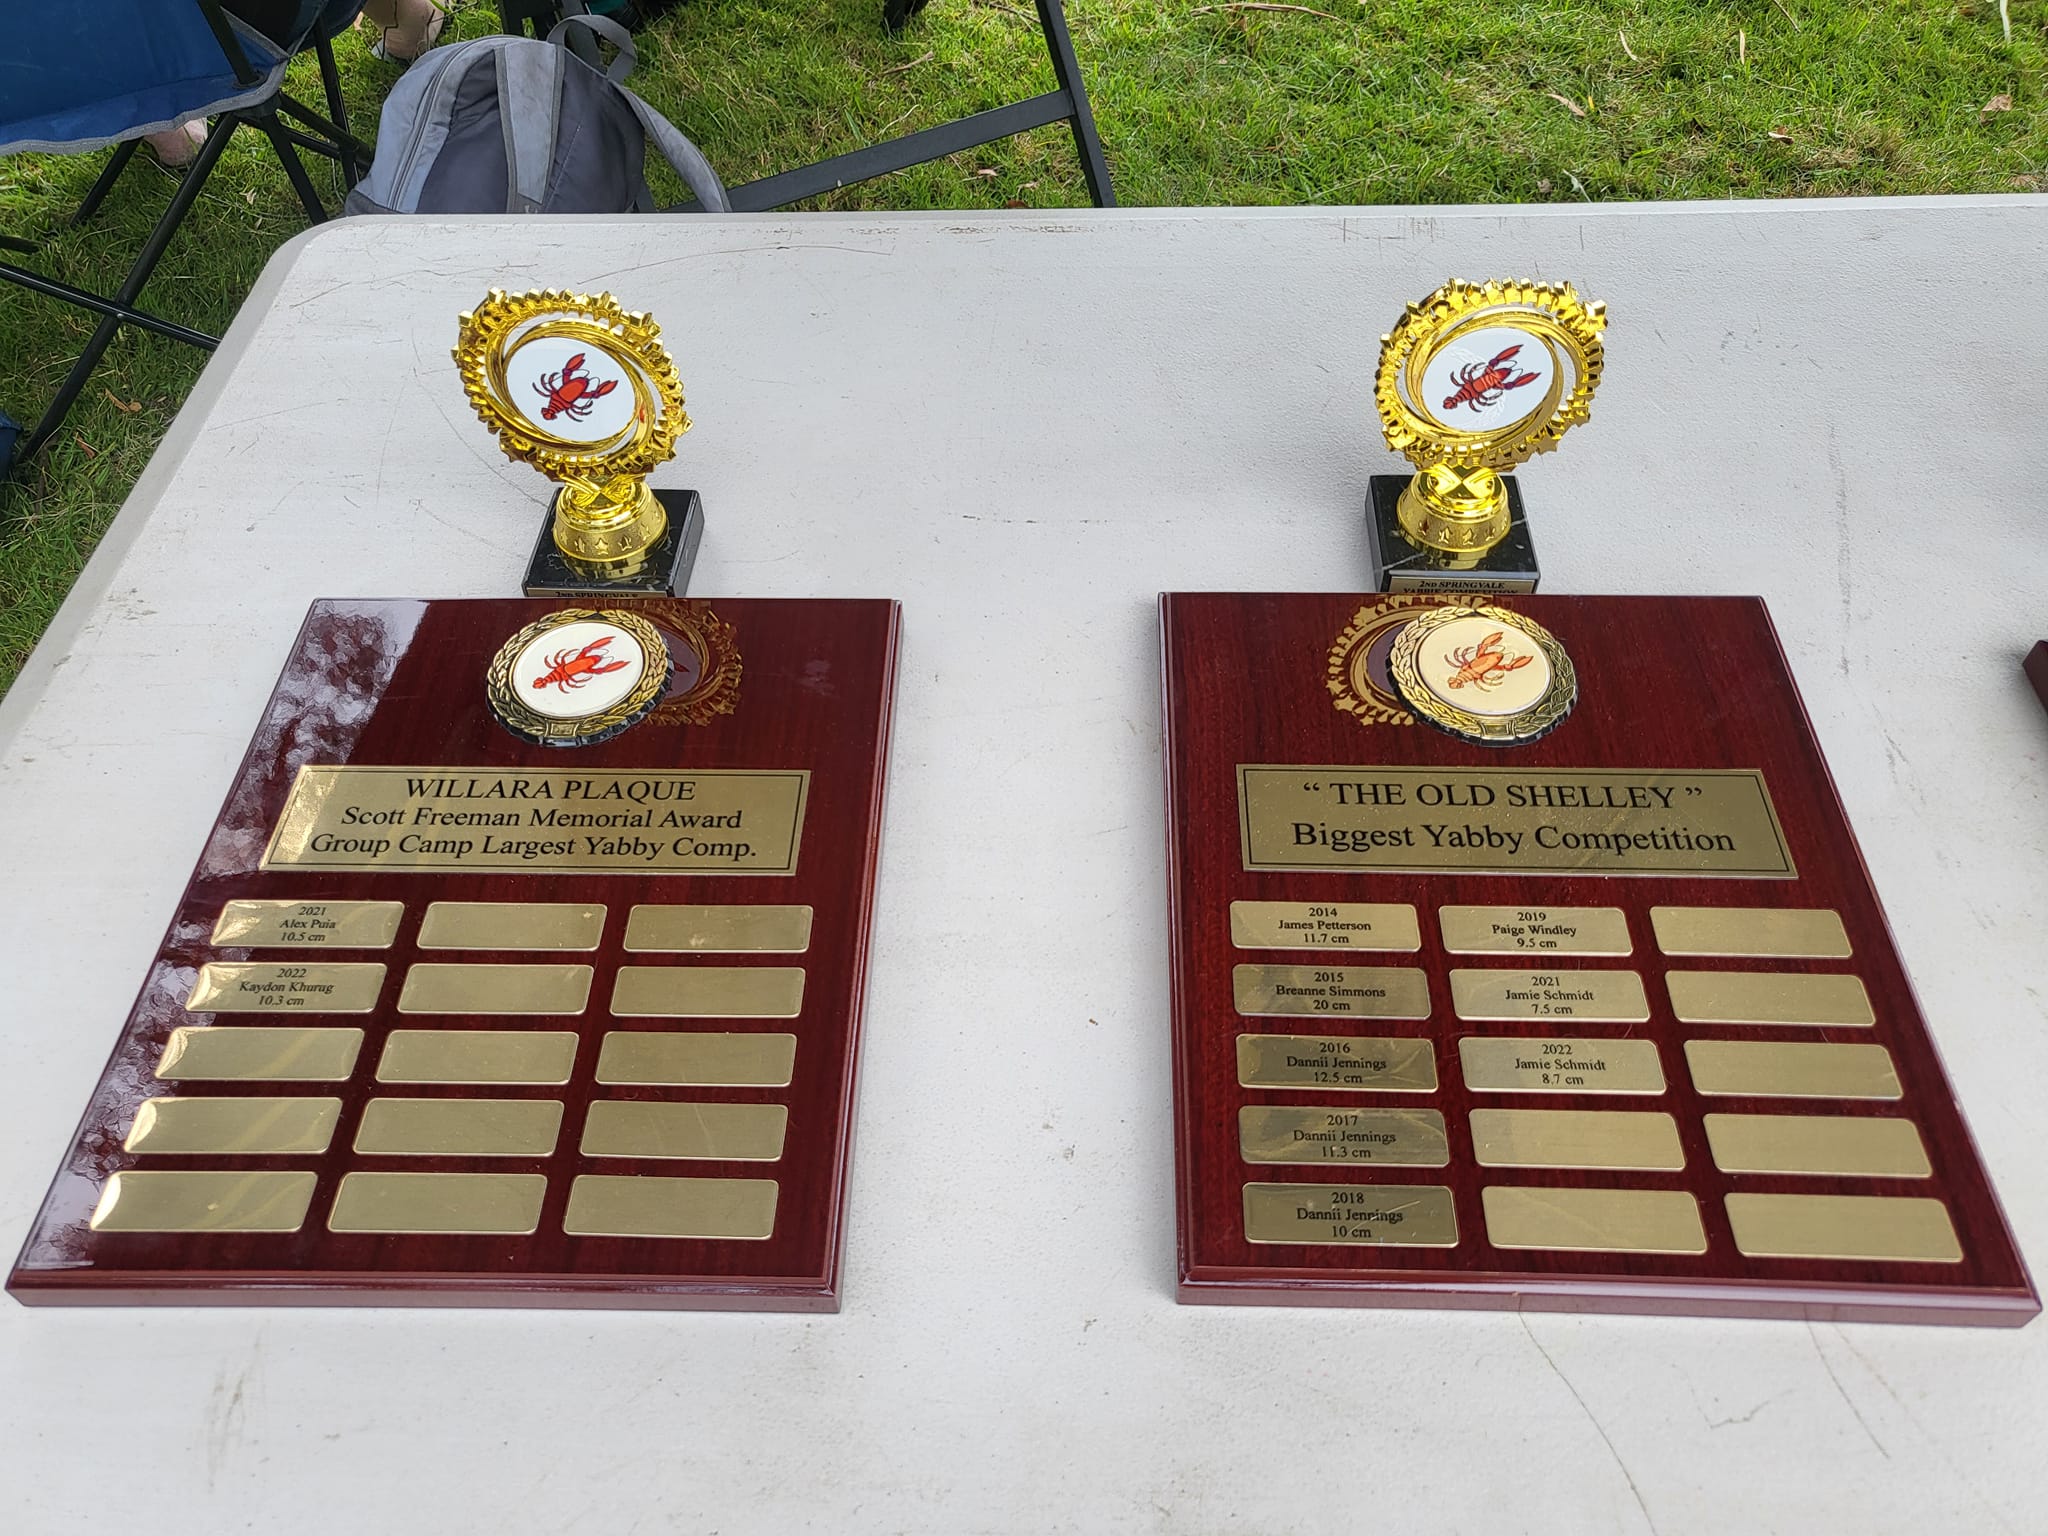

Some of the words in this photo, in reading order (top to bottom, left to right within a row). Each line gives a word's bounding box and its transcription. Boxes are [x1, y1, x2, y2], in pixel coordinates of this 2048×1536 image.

[1438, 581, 1505, 589] SPRINGVALE
[406, 779, 553, 800] WILLARA
[563, 780, 696, 802] PLAQUE
[1330, 783, 1407, 805] THE
[1416, 783, 1495, 806] OLD
[1508, 785, 1676, 808] SHELLEY
[341, 806, 406, 825] Scott
[413, 807, 520, 826] Freeman
[528, 807, 653, 828] Memorial
[658, 809, 742, 829] Award
[1292, 822, 1415, 851] Biggest
[1422, 823, 1523, 854] Yabby
[1535, 826, 1736, 857] Competition
[310, 833, 391, 857] Group
[398, 834, 474, 858] Camp
[480, 835, 576, 859] Largest
[585, 836, 664, 860] Yabby
[672, 837, 757, 861] Comp.
[298, 907, 326, 916] 2021
[1309, 908, 1337, 917] 2014
[1517, 912, 1546, 921] 2019
[279, 919, 307, 929] Alex
[1278, 920, 1314, 930] James
[1318, 921, 1371, 931] Petterson
[1492, 925, 1524, 936] Paige
[1528, 925, 1576, 937] Windley
[280, 932, 305, 942] 10.5
[307, 934, 325, 942] cm
[1304, 933, 1328, 943] 11.7
[1517, 938, 1535, 948] 9.5
[1539, 940, 1557, 948] cm
[276, 968, 307, 978] 2022
[1314, 972, 1344, 982] 2015
[1531, 977, 1560, 986] 2021
[239, 982, 285, 993] Kaydon
[1276, 985, 1325, 996] Breanne
[1329, 986, 1386, 997] Simmons
[258, 996, 284, 1005] 10.3
[1505, 990, 1540, 1000] Jamie
[1544, 990, 1594, 1001] Schmidt
[1313, 1000, 1328, 1010] 20
[1332, 1002, 1350, 1010] cm
[1532, 1004, 1551, 1014] 7.5
[1319, 1042, 1350, 1053] 2016
[1542, 1045, 1572, 1055] 2022
[1287, 1056, 1328, 1067] Dannii
[1331, 1057, 1386, 1071] Jennings
[1514, 1058, 1550, 1070] Jamie
[1554, 1059, 1606, 1071] Schmidt
[1314, 1072, 1340, 1082] 12.5
[1344, 1074, 1362, 1083] cm
[1542, 1074, 1560, 1085] 8.7
[1565, 1077, 1584, 1085] cm
[1327, 1115, 1358, 1126] 2017
[1293, 1130, 1336, 1141] Dannii
[1340, 1131, 1396, 1145] Jennings
[1321, 1147, 1348, 1158] 11.3
[1352, 1149, 1371, 1158] cm
[1331, 1192, 1364, 1204] 2018
[1296, 1208, 1341, 1220] Dannii
[1345, 1209, 1403, 1224] Jennings
[1332, 1226, 1348, 1237] 10
[1352, 1228, 1371, 1238] cm
